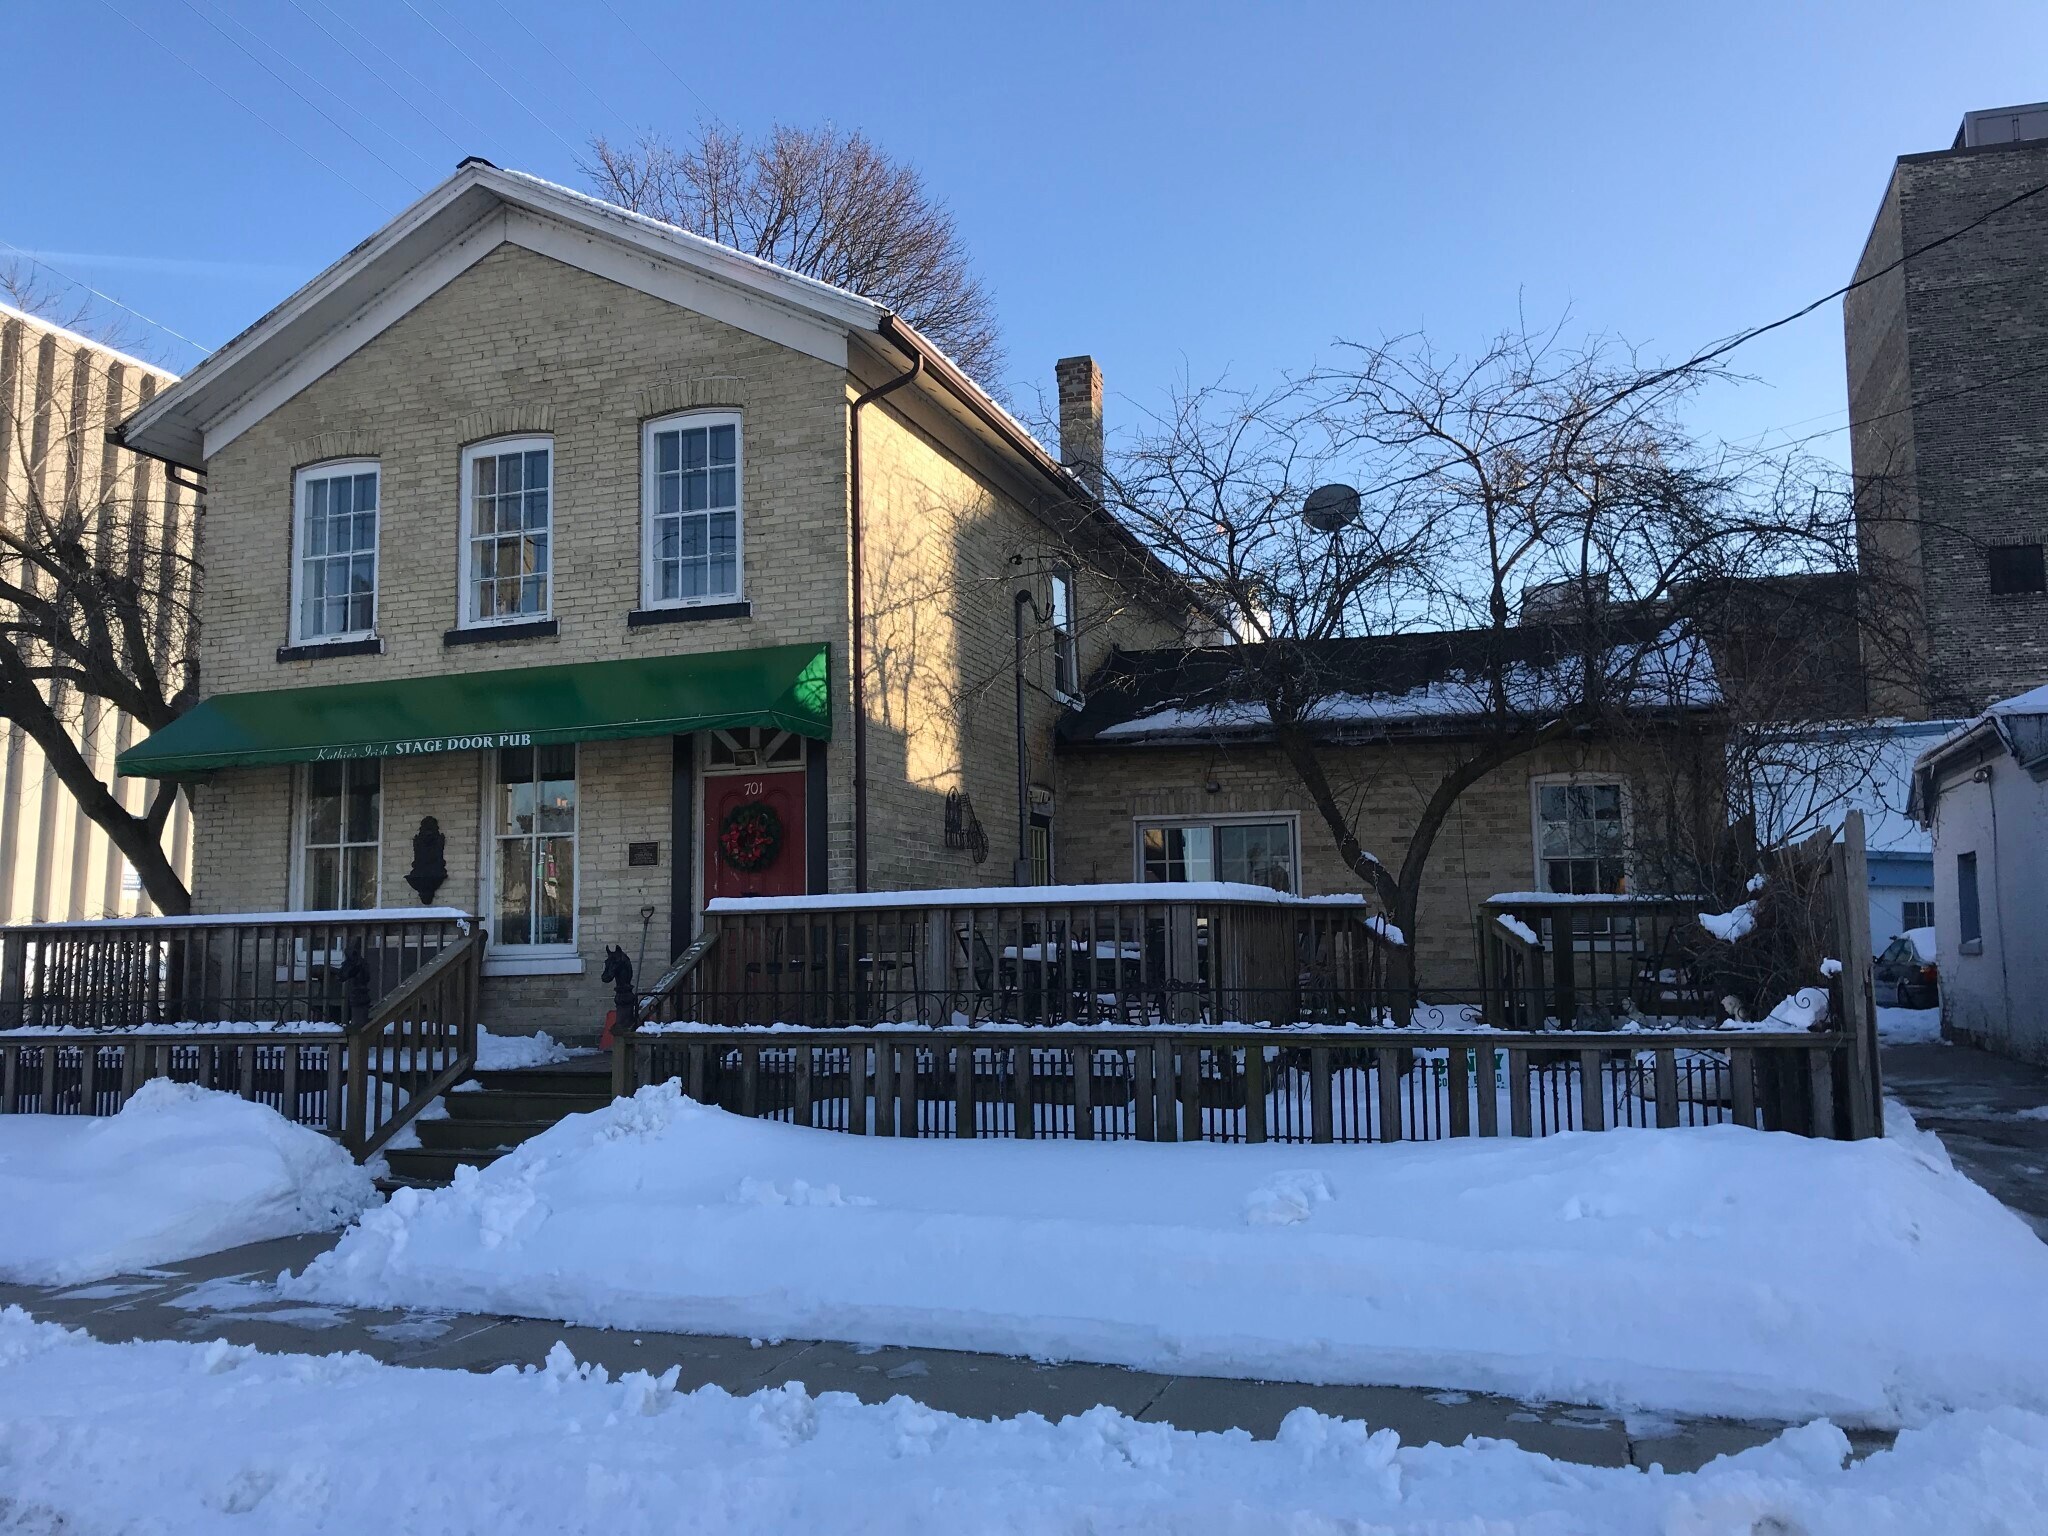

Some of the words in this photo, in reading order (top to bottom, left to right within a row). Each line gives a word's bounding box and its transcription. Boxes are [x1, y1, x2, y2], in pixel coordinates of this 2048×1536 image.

[311, 747, 357, 761] Kathie's
[361, 744, 388, 757] Irish
[395, 740, 443, 755] STAGE
[447, 736, 493, 751] DOOR
[499, 733, 531, 747] PUB
[744, 781, 763, 796] 701
